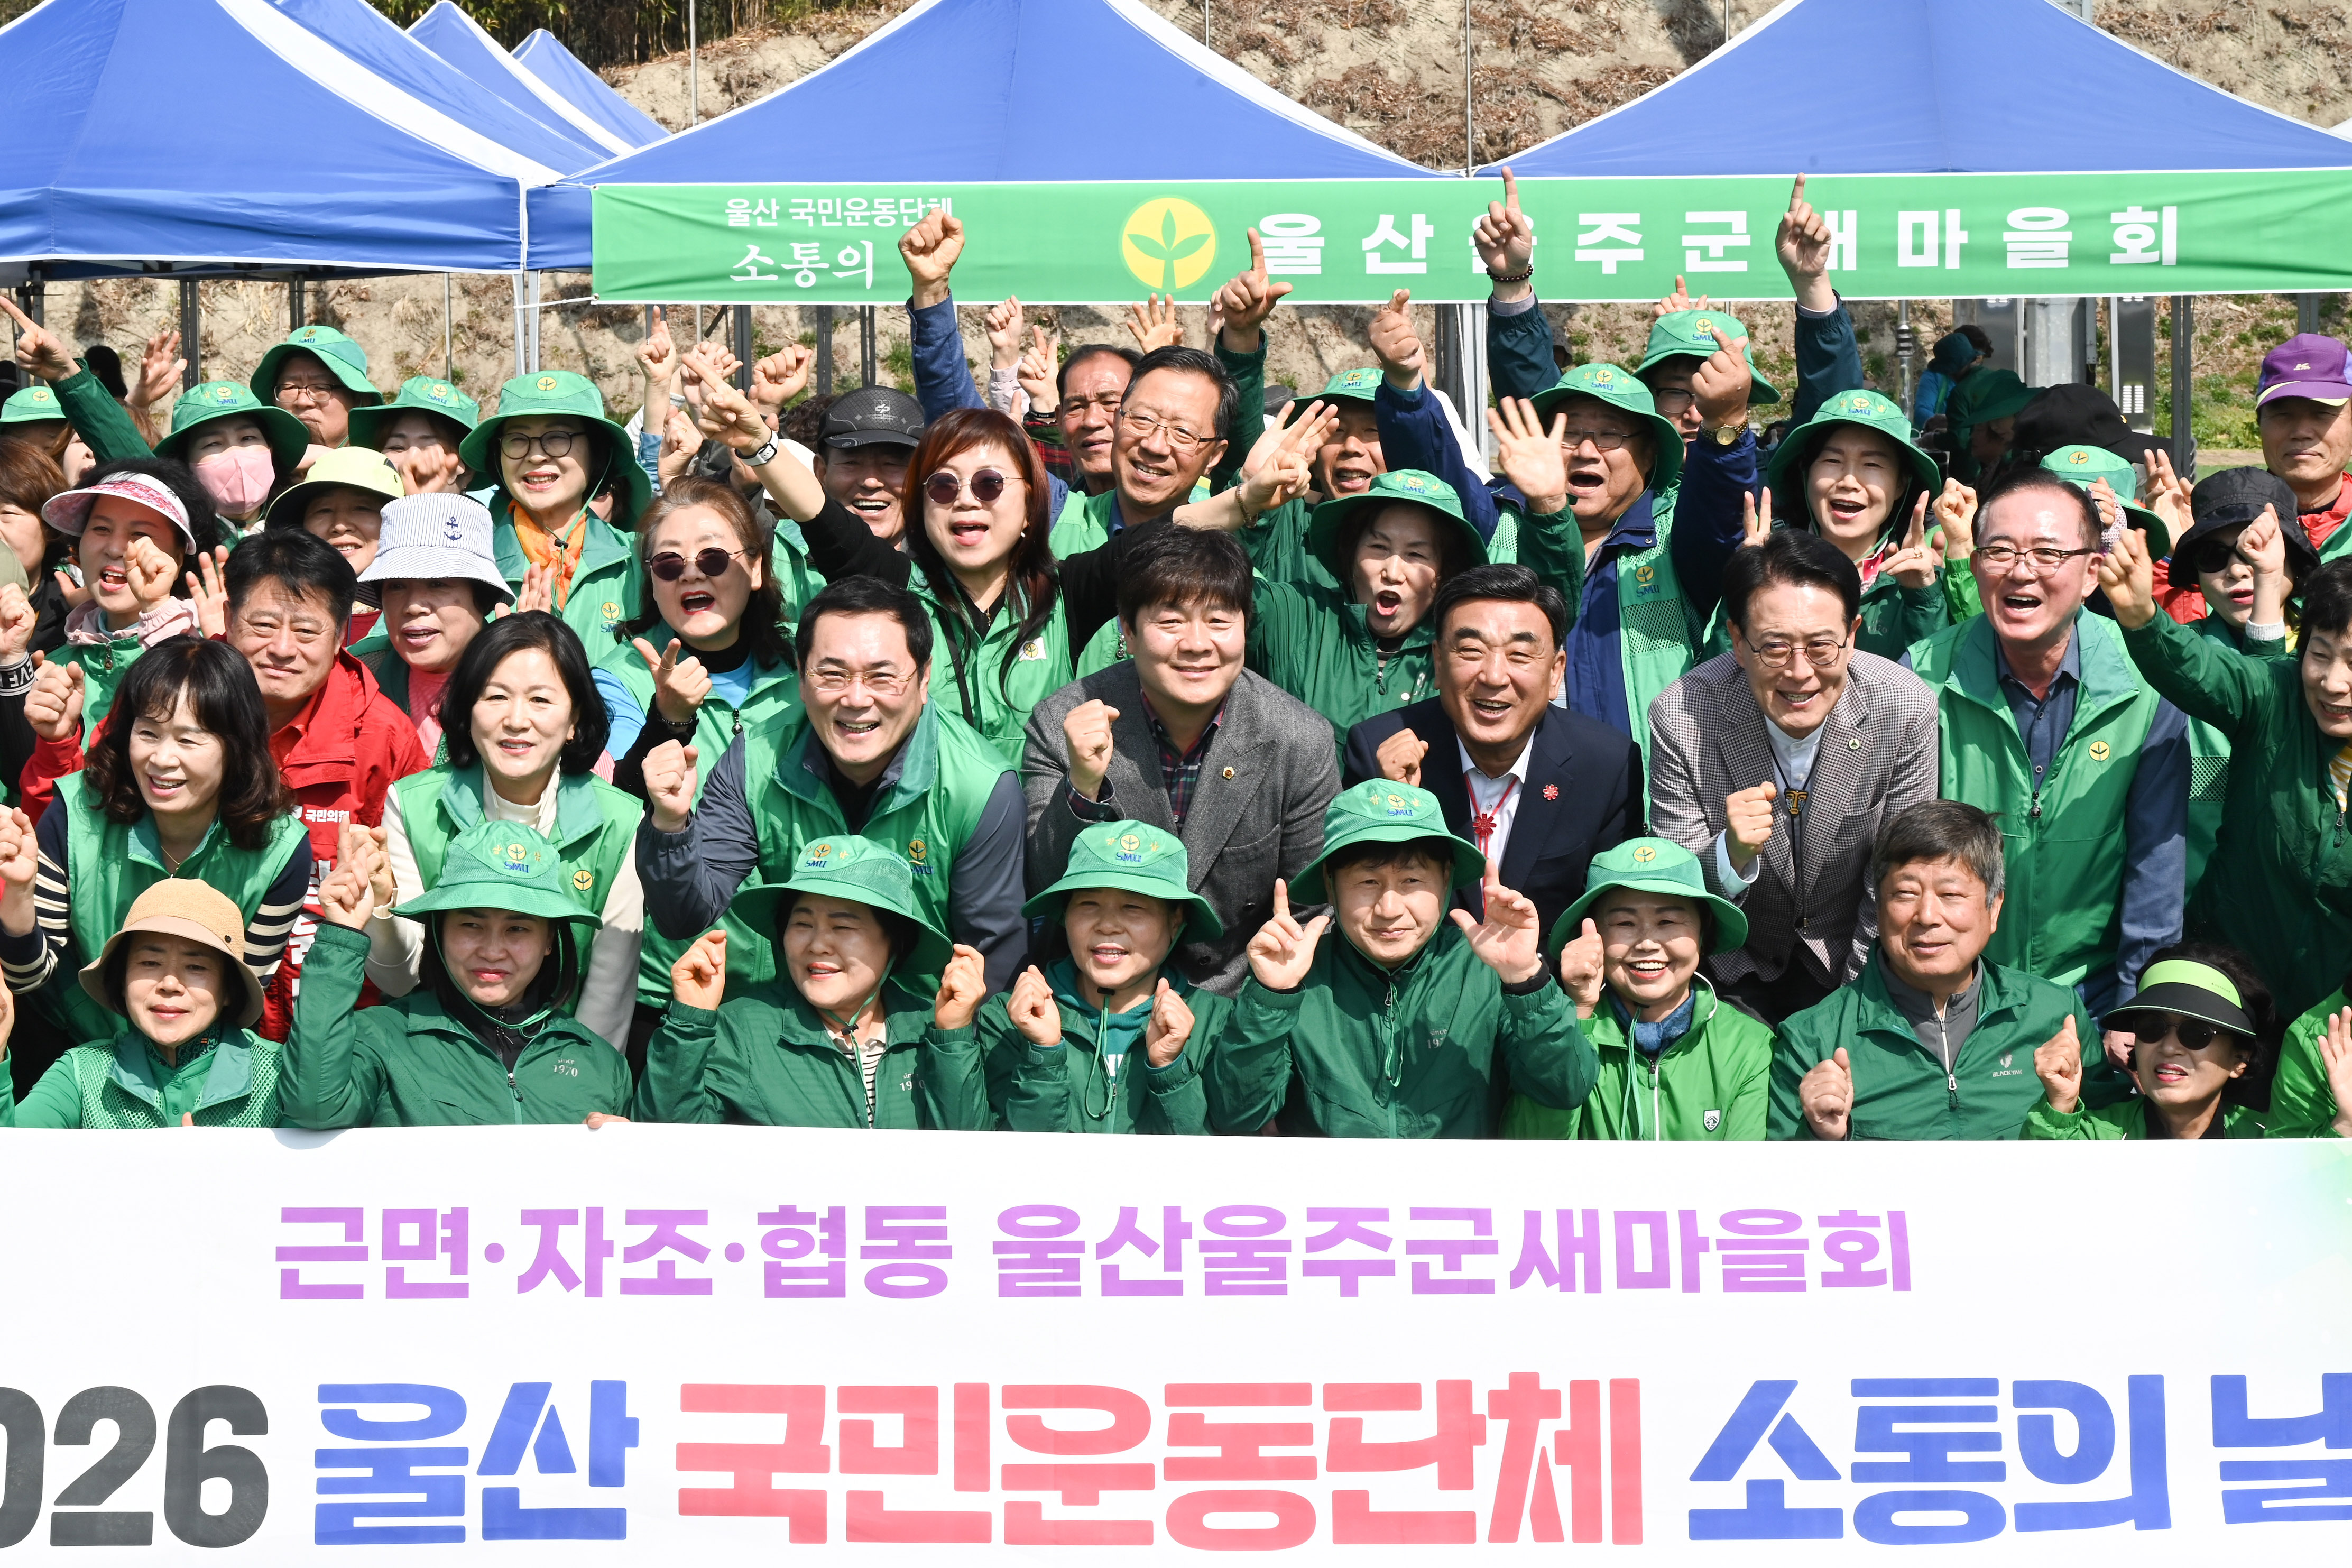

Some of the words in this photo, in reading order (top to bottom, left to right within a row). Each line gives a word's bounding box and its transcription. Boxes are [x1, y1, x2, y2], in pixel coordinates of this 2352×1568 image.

[725, 198, 780, 227] 울산
[730, 240, 873, 290] 소통의
[1591, 382, 1614, 391] SMU
[426, 393, 447, 404] SMU
[1403, 485, 1426, 494] SMU
[1636, 587, 1660, 597] SMU
[1115, 853, 1141, 862] SMU
[504, 861, 529, 873] SMU
[910, 865, 934, 875] MU
[1426, 1038, 1444, 1049] 197
[554, 1064, 579, 1077] 1970
[1992, 1069, 2023, 1078] BLACKYAK
[899, 1080, 925, 1091] 190
[275, 1204, 953, 1300] 근면·자조·협동
[992, 1204, 1912, 1298] 울산울주군새마을회
[314, 1379, 640, 1546] 울산
[675, 1371, 1644, 1552] 국민운동단체
[1688, 1373, 2172, 1546] 소통의
